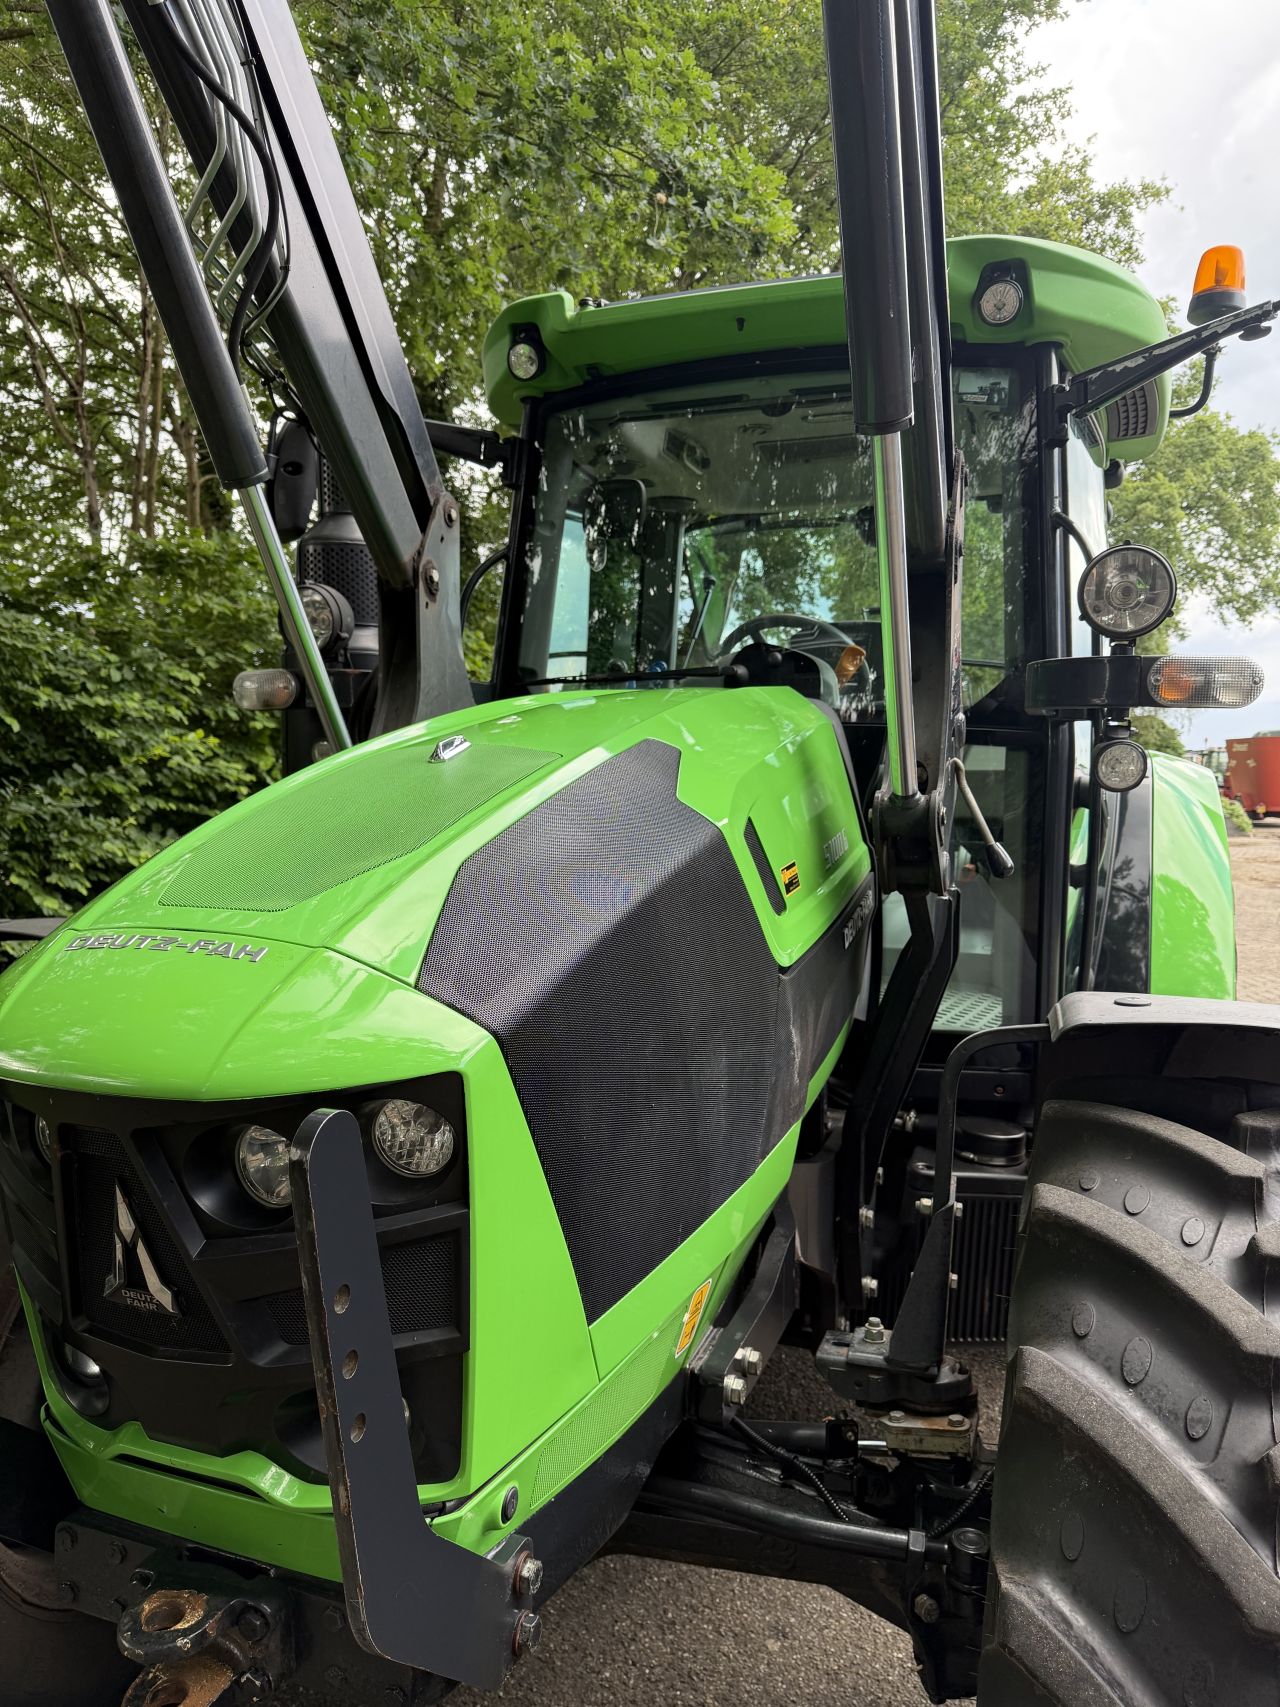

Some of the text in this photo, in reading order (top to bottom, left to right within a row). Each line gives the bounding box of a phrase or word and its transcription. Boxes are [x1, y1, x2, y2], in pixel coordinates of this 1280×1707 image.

[65, 934, 268, 962] DEUTZ-FAH
[121, 1289, 159, 1303] DEUTZ
[126, 1298, 158, 1311] FAHR
